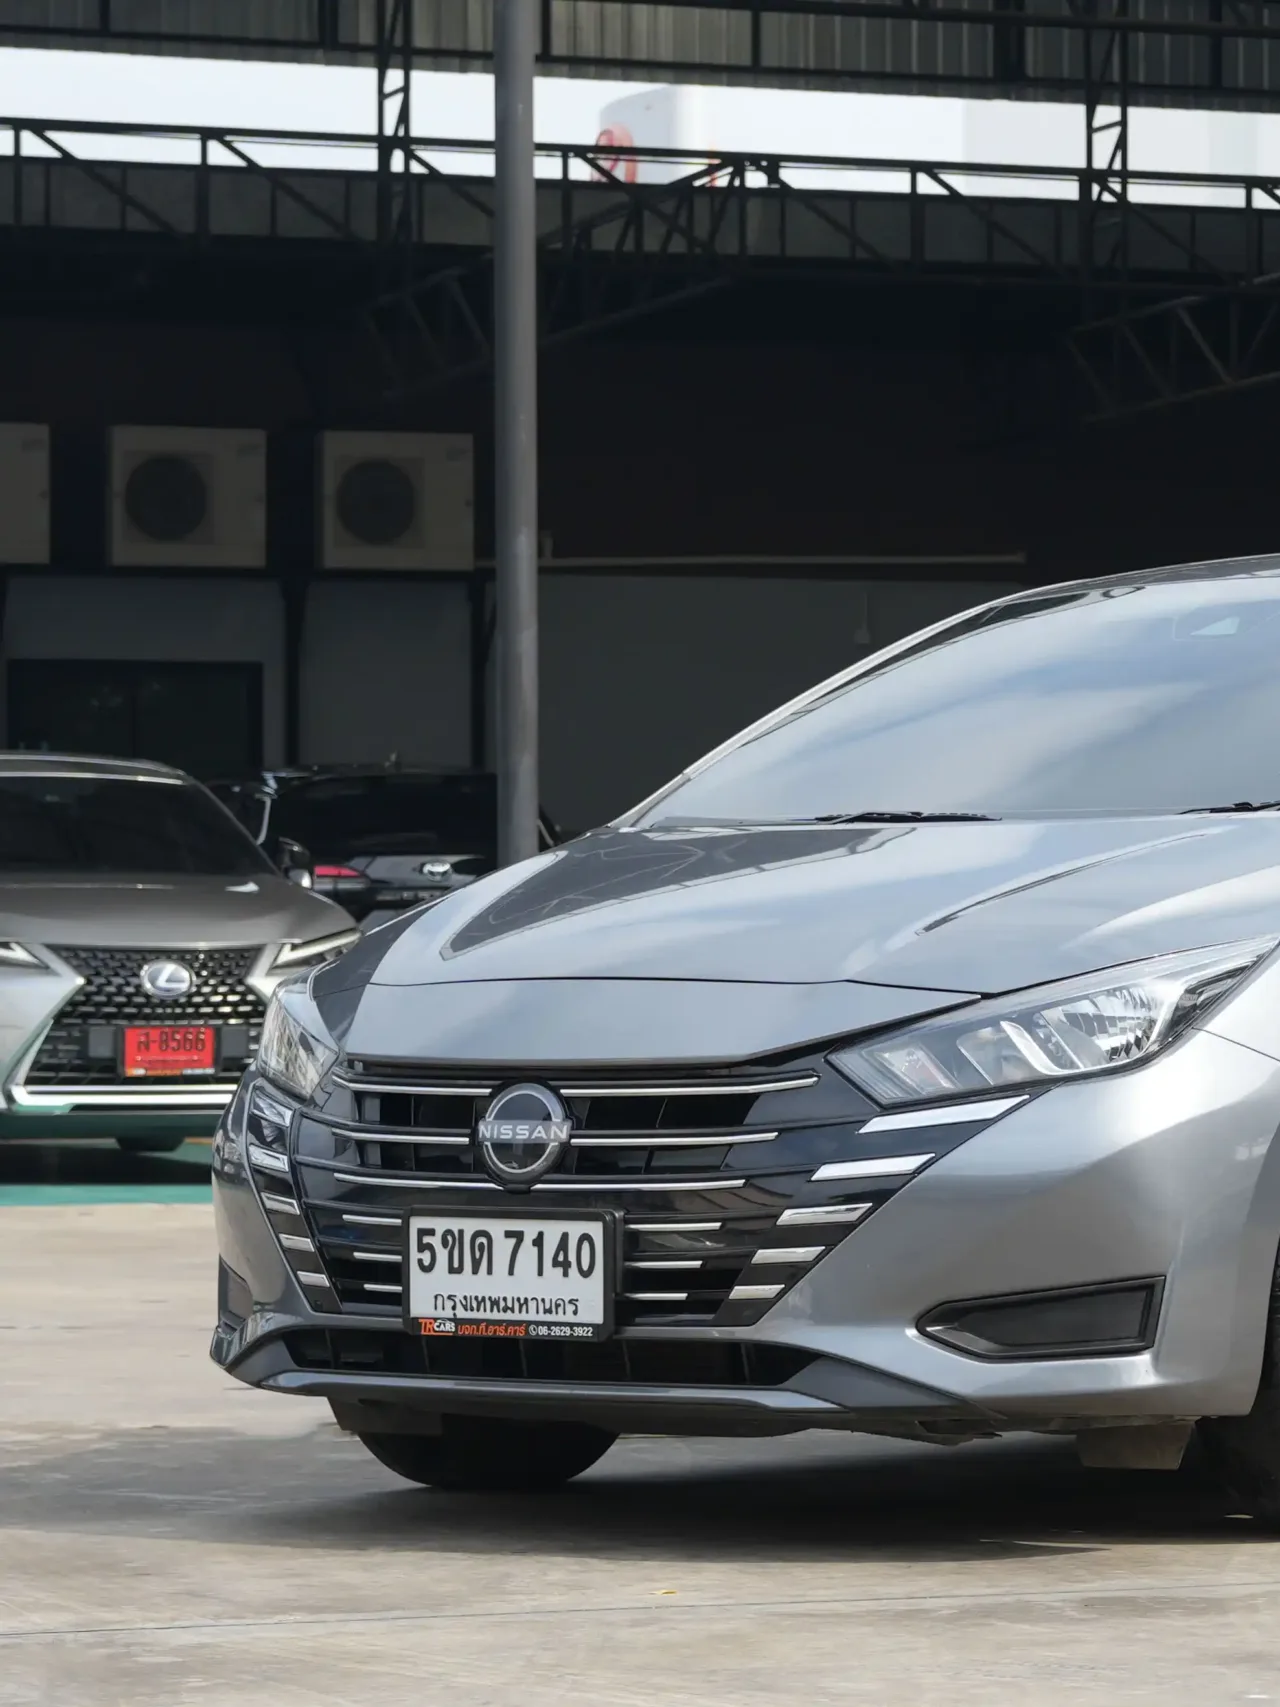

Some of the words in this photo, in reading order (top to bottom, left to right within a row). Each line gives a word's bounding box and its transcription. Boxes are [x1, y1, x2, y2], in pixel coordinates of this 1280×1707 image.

[479, 1125, 568, 1138] NISSAN
[416, 1227, 493, 1275] 5ขด
[504, 1230, 596, 1278] 7140
[433, 1292, 579, 1318] กรุงเทพมหานคร
[537, 1326, 593, 1337] 06-2629-3922
